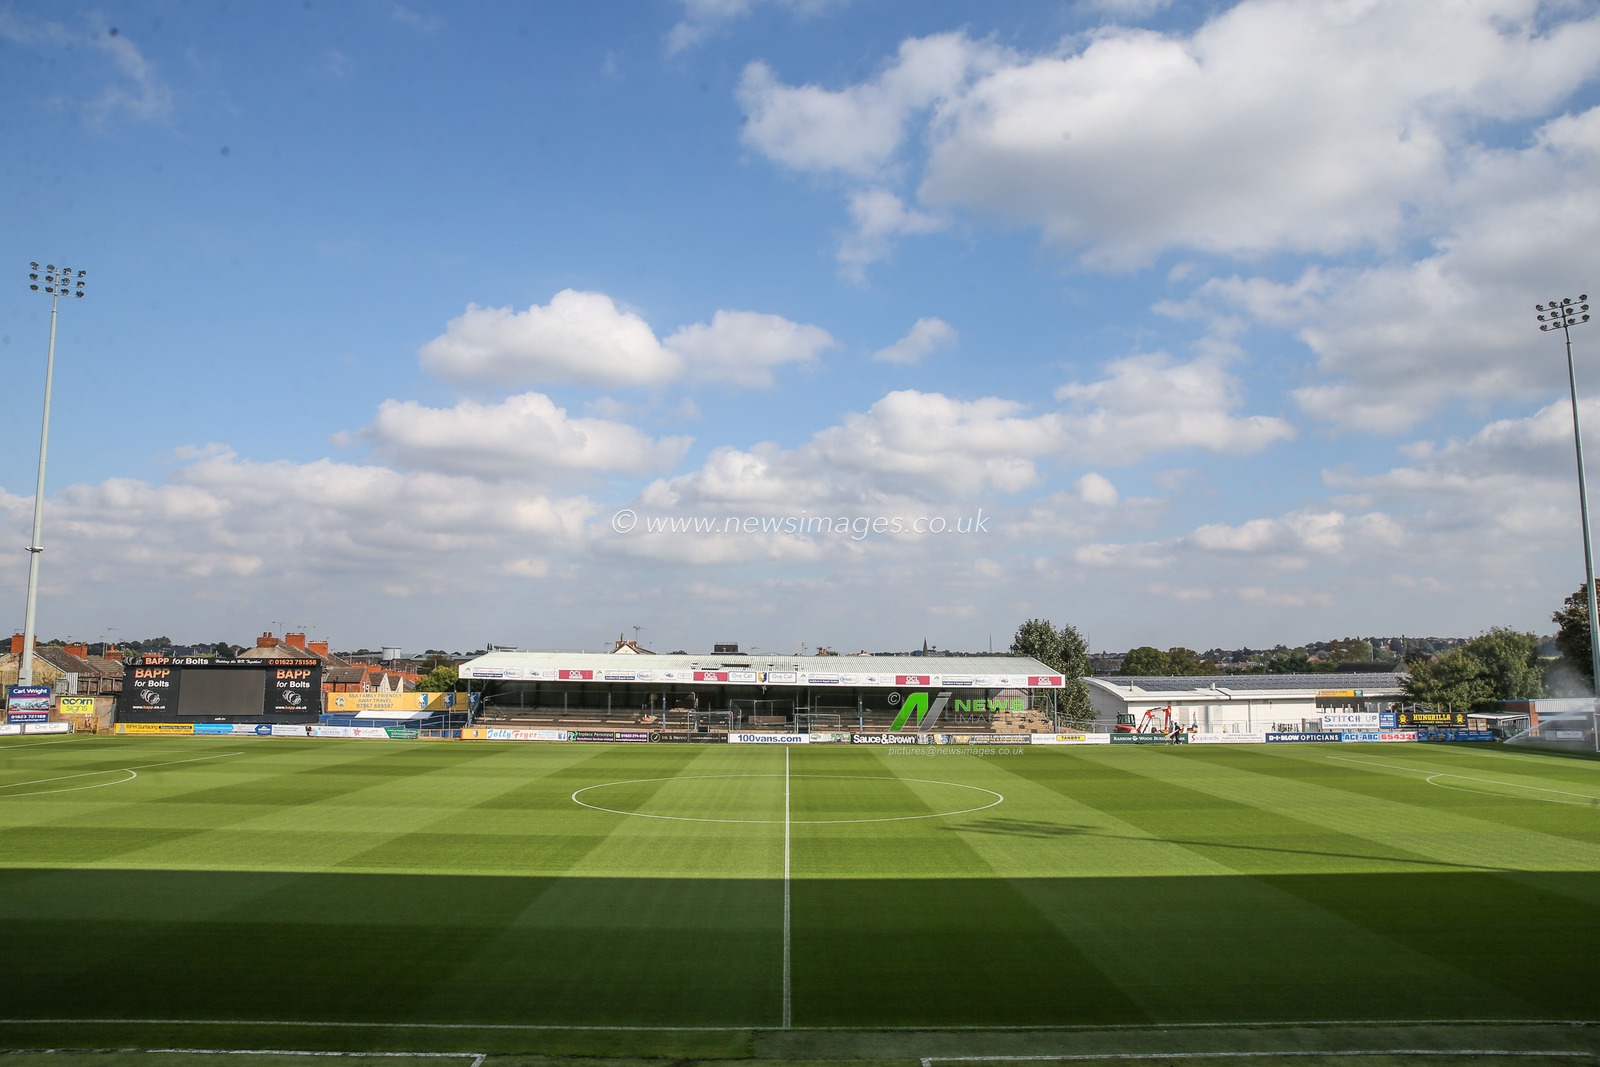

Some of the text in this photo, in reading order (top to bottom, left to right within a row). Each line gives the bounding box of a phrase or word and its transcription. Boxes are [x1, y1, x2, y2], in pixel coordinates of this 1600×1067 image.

[135, 669, 170, 678] BAPP
[276, 669, 311, 679] BAPP
[66, 704, 88, 713] signs
[487, 730, 512, 739] Jolly
[512, 730, 537, 739] Fryer
[738, 735, 802, 743] 100vans.com
